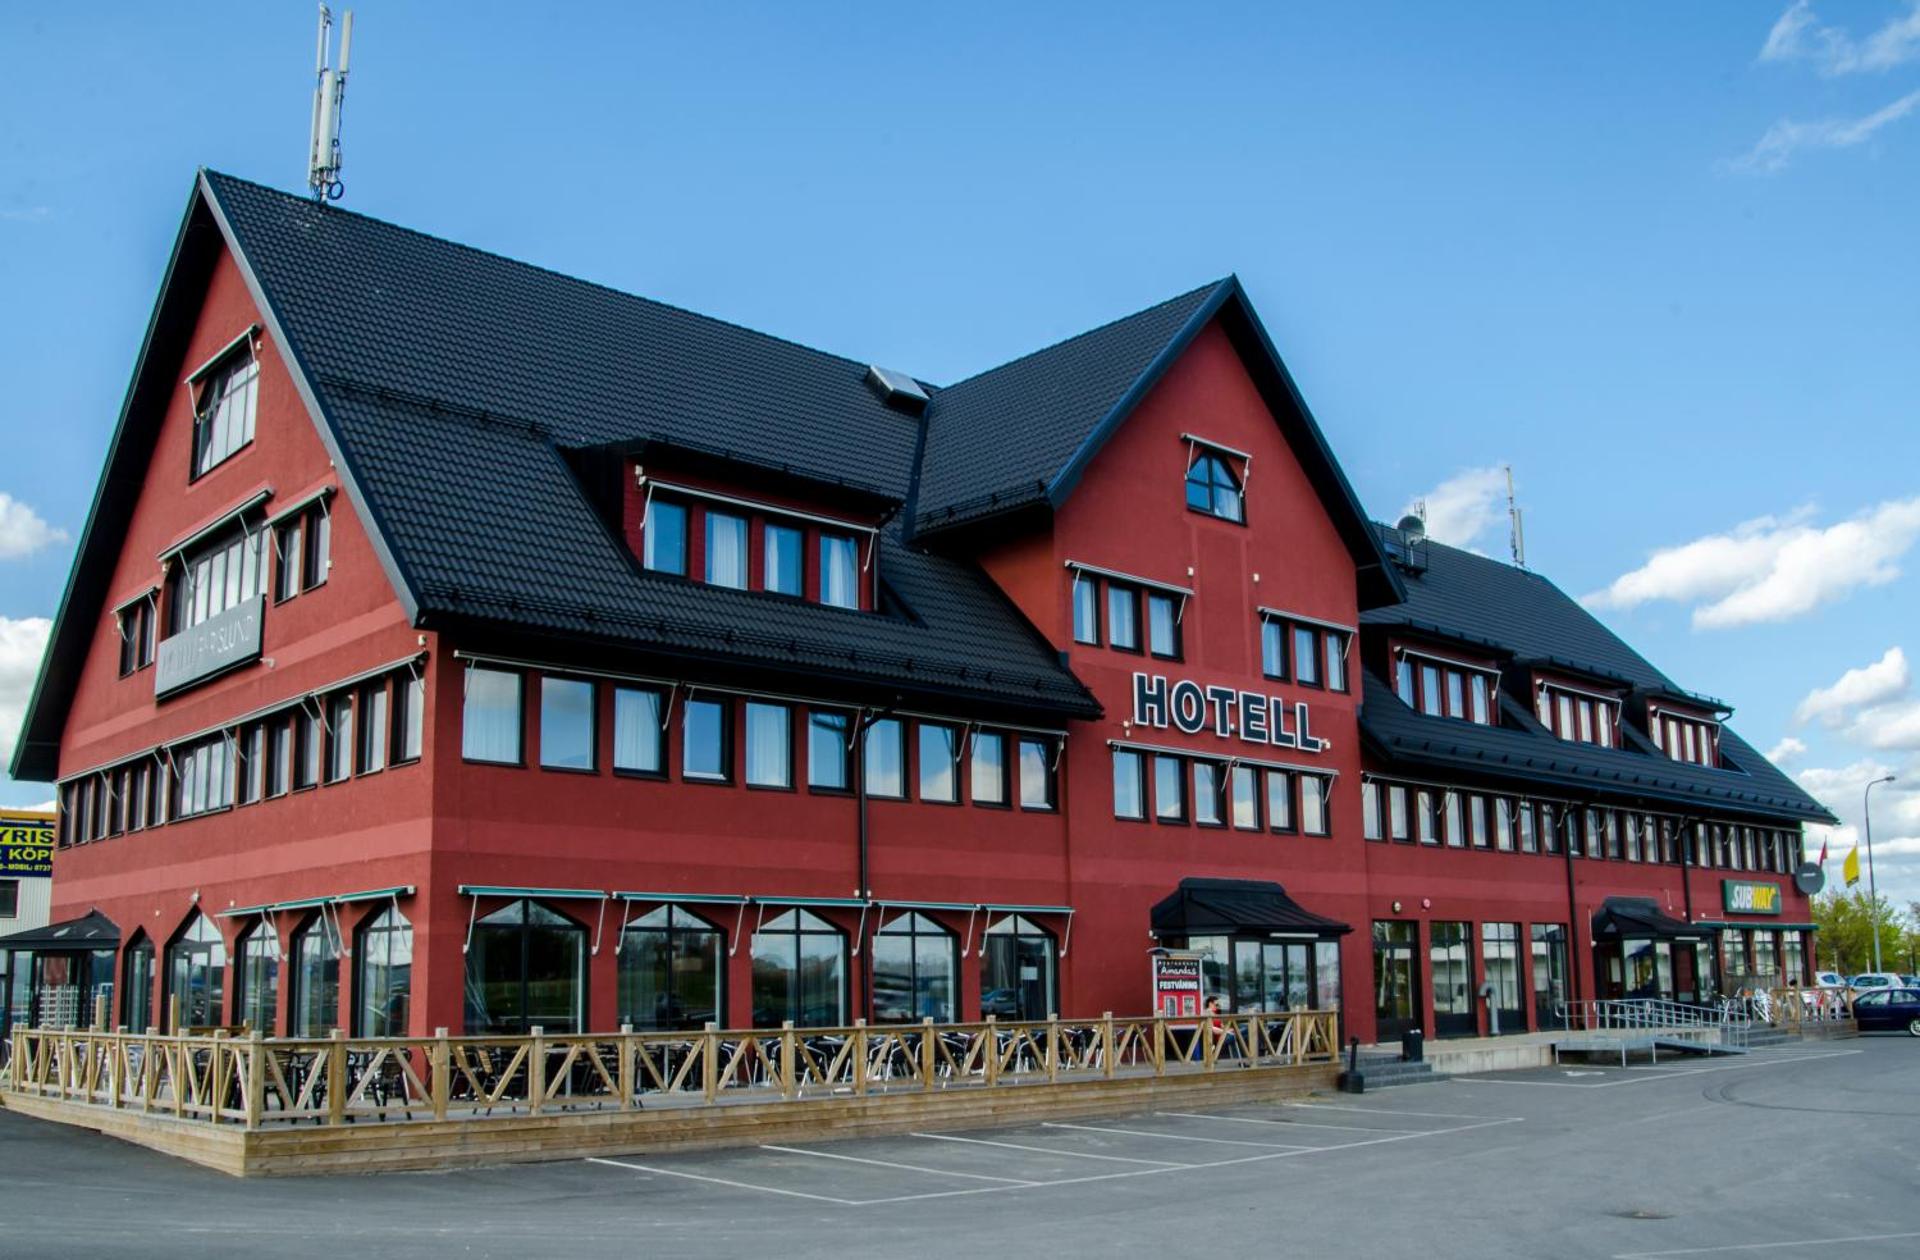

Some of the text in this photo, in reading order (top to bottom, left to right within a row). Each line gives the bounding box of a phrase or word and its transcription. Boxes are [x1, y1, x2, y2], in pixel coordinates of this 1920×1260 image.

[1133, 672, 1323, 752] HOTELL
[1731, 885, 1776, 910] SUBWAY
[1159, 979, 1198, 990] FESTVÅNING
